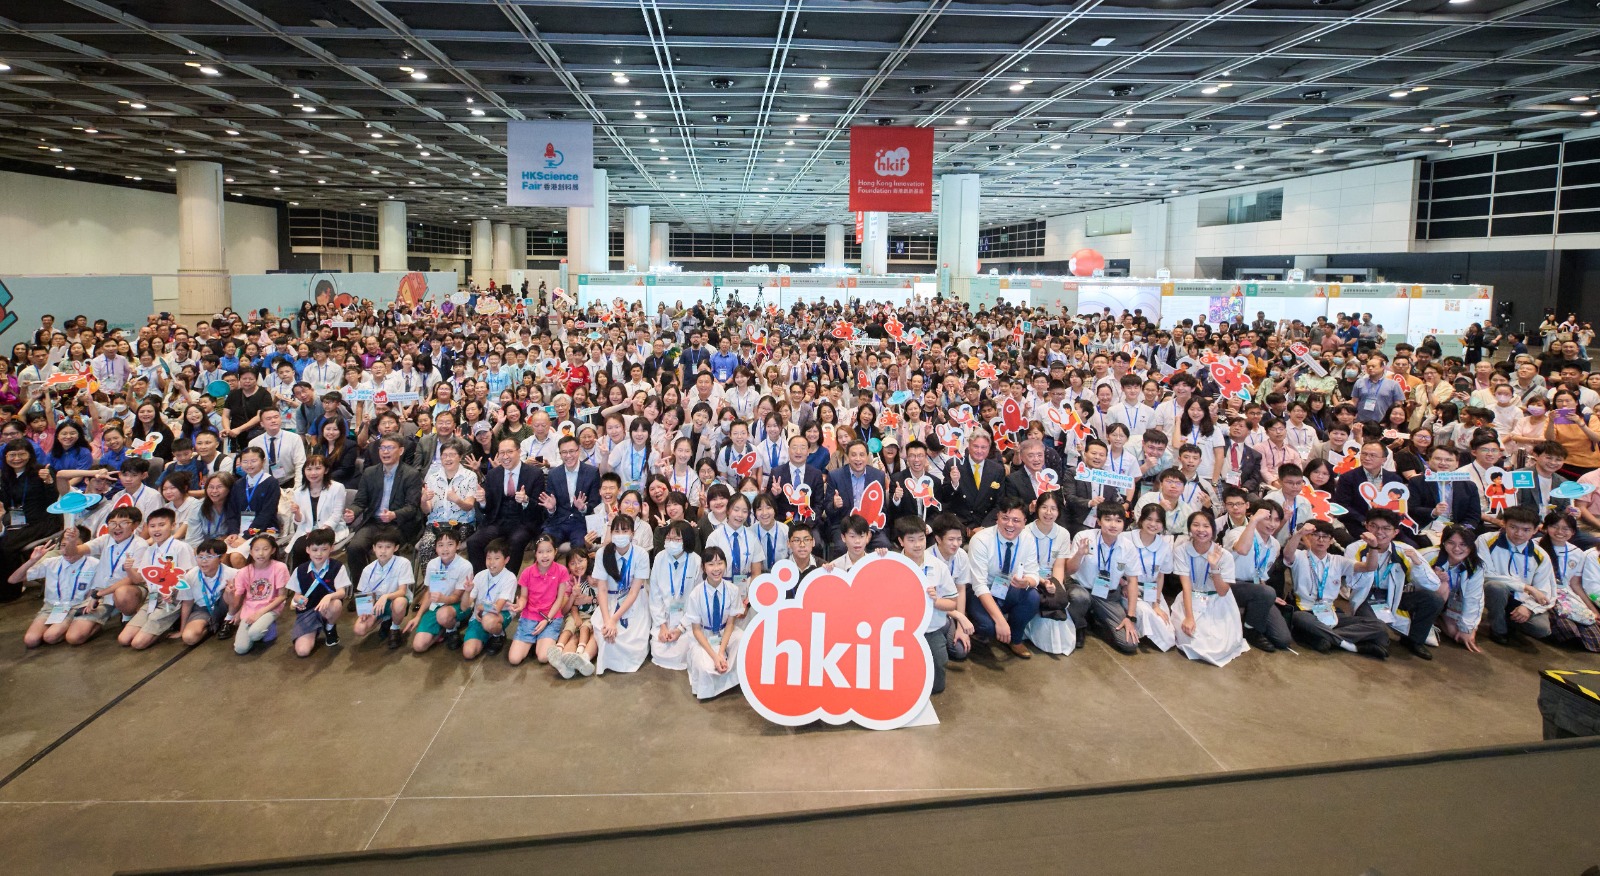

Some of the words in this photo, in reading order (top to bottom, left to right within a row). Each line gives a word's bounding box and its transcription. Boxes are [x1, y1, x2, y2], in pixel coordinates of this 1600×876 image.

[877, 157, 906, 171] hkif
[521, 171, 579, 181] HKScience
[521, 181, 542, 190] Fair
[858, 179, 875, 187] Hong
[876, 179, 893, 187] Kong
[857, 186, 892, 194] Foundation
[1092, 470, 1133, 481] HKScience
[760, 607, 905, 691] hkif
